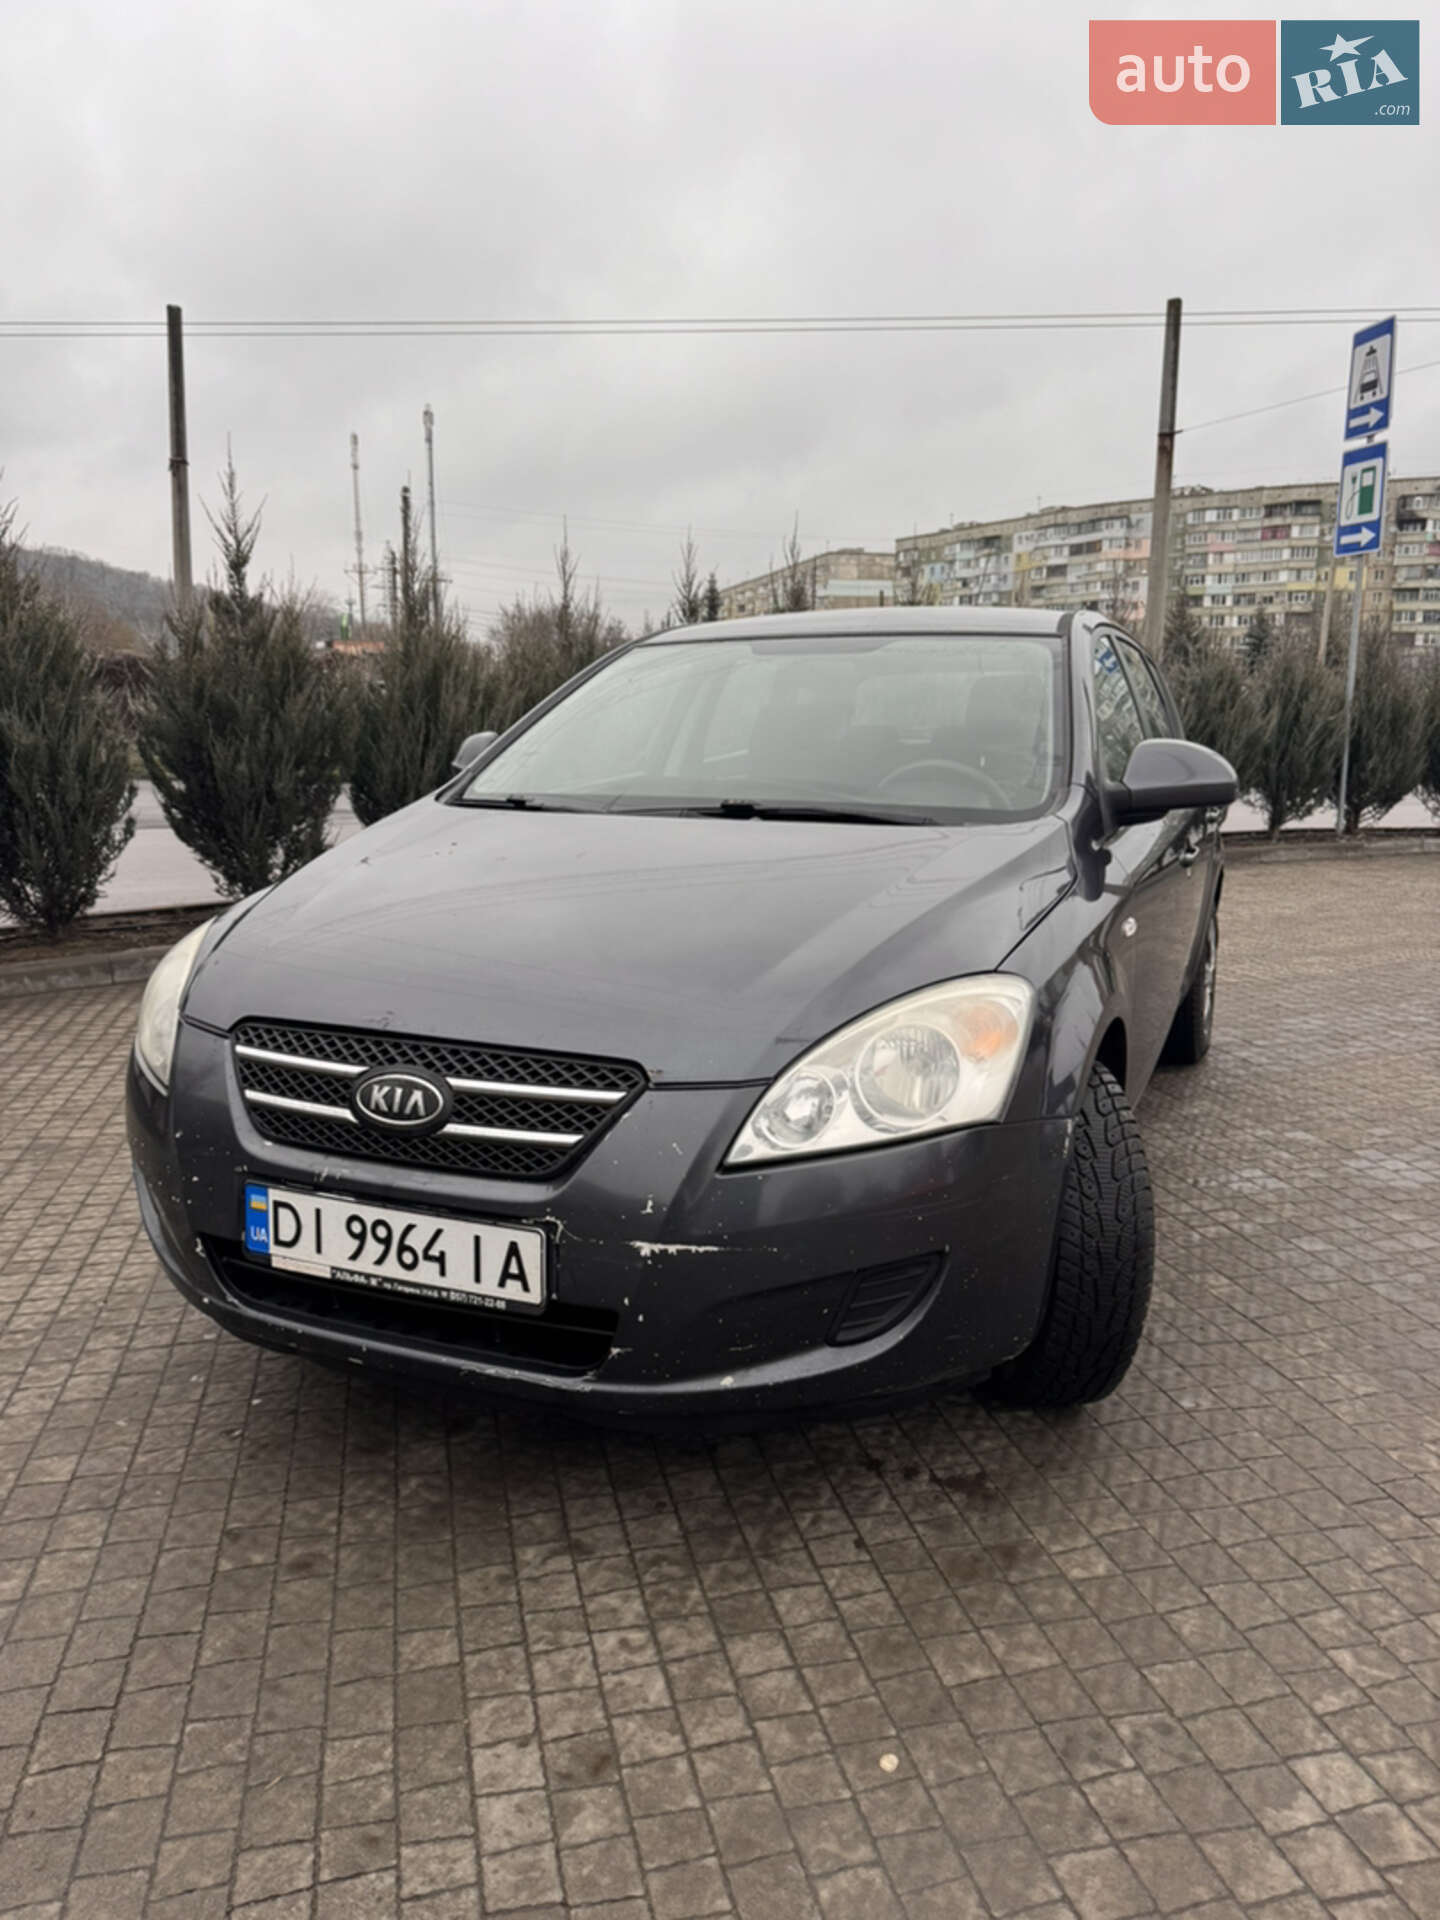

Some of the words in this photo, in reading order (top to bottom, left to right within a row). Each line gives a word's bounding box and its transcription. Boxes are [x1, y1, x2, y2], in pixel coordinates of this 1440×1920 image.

[370, 1084, 427, 1117] KIA
[250, 1225, 268, 1243] UA
[272, 1200, 322, 1255] DI
[345, 1214, 447, 1277] 9964
[473, 1235, 531, 1293] IA
